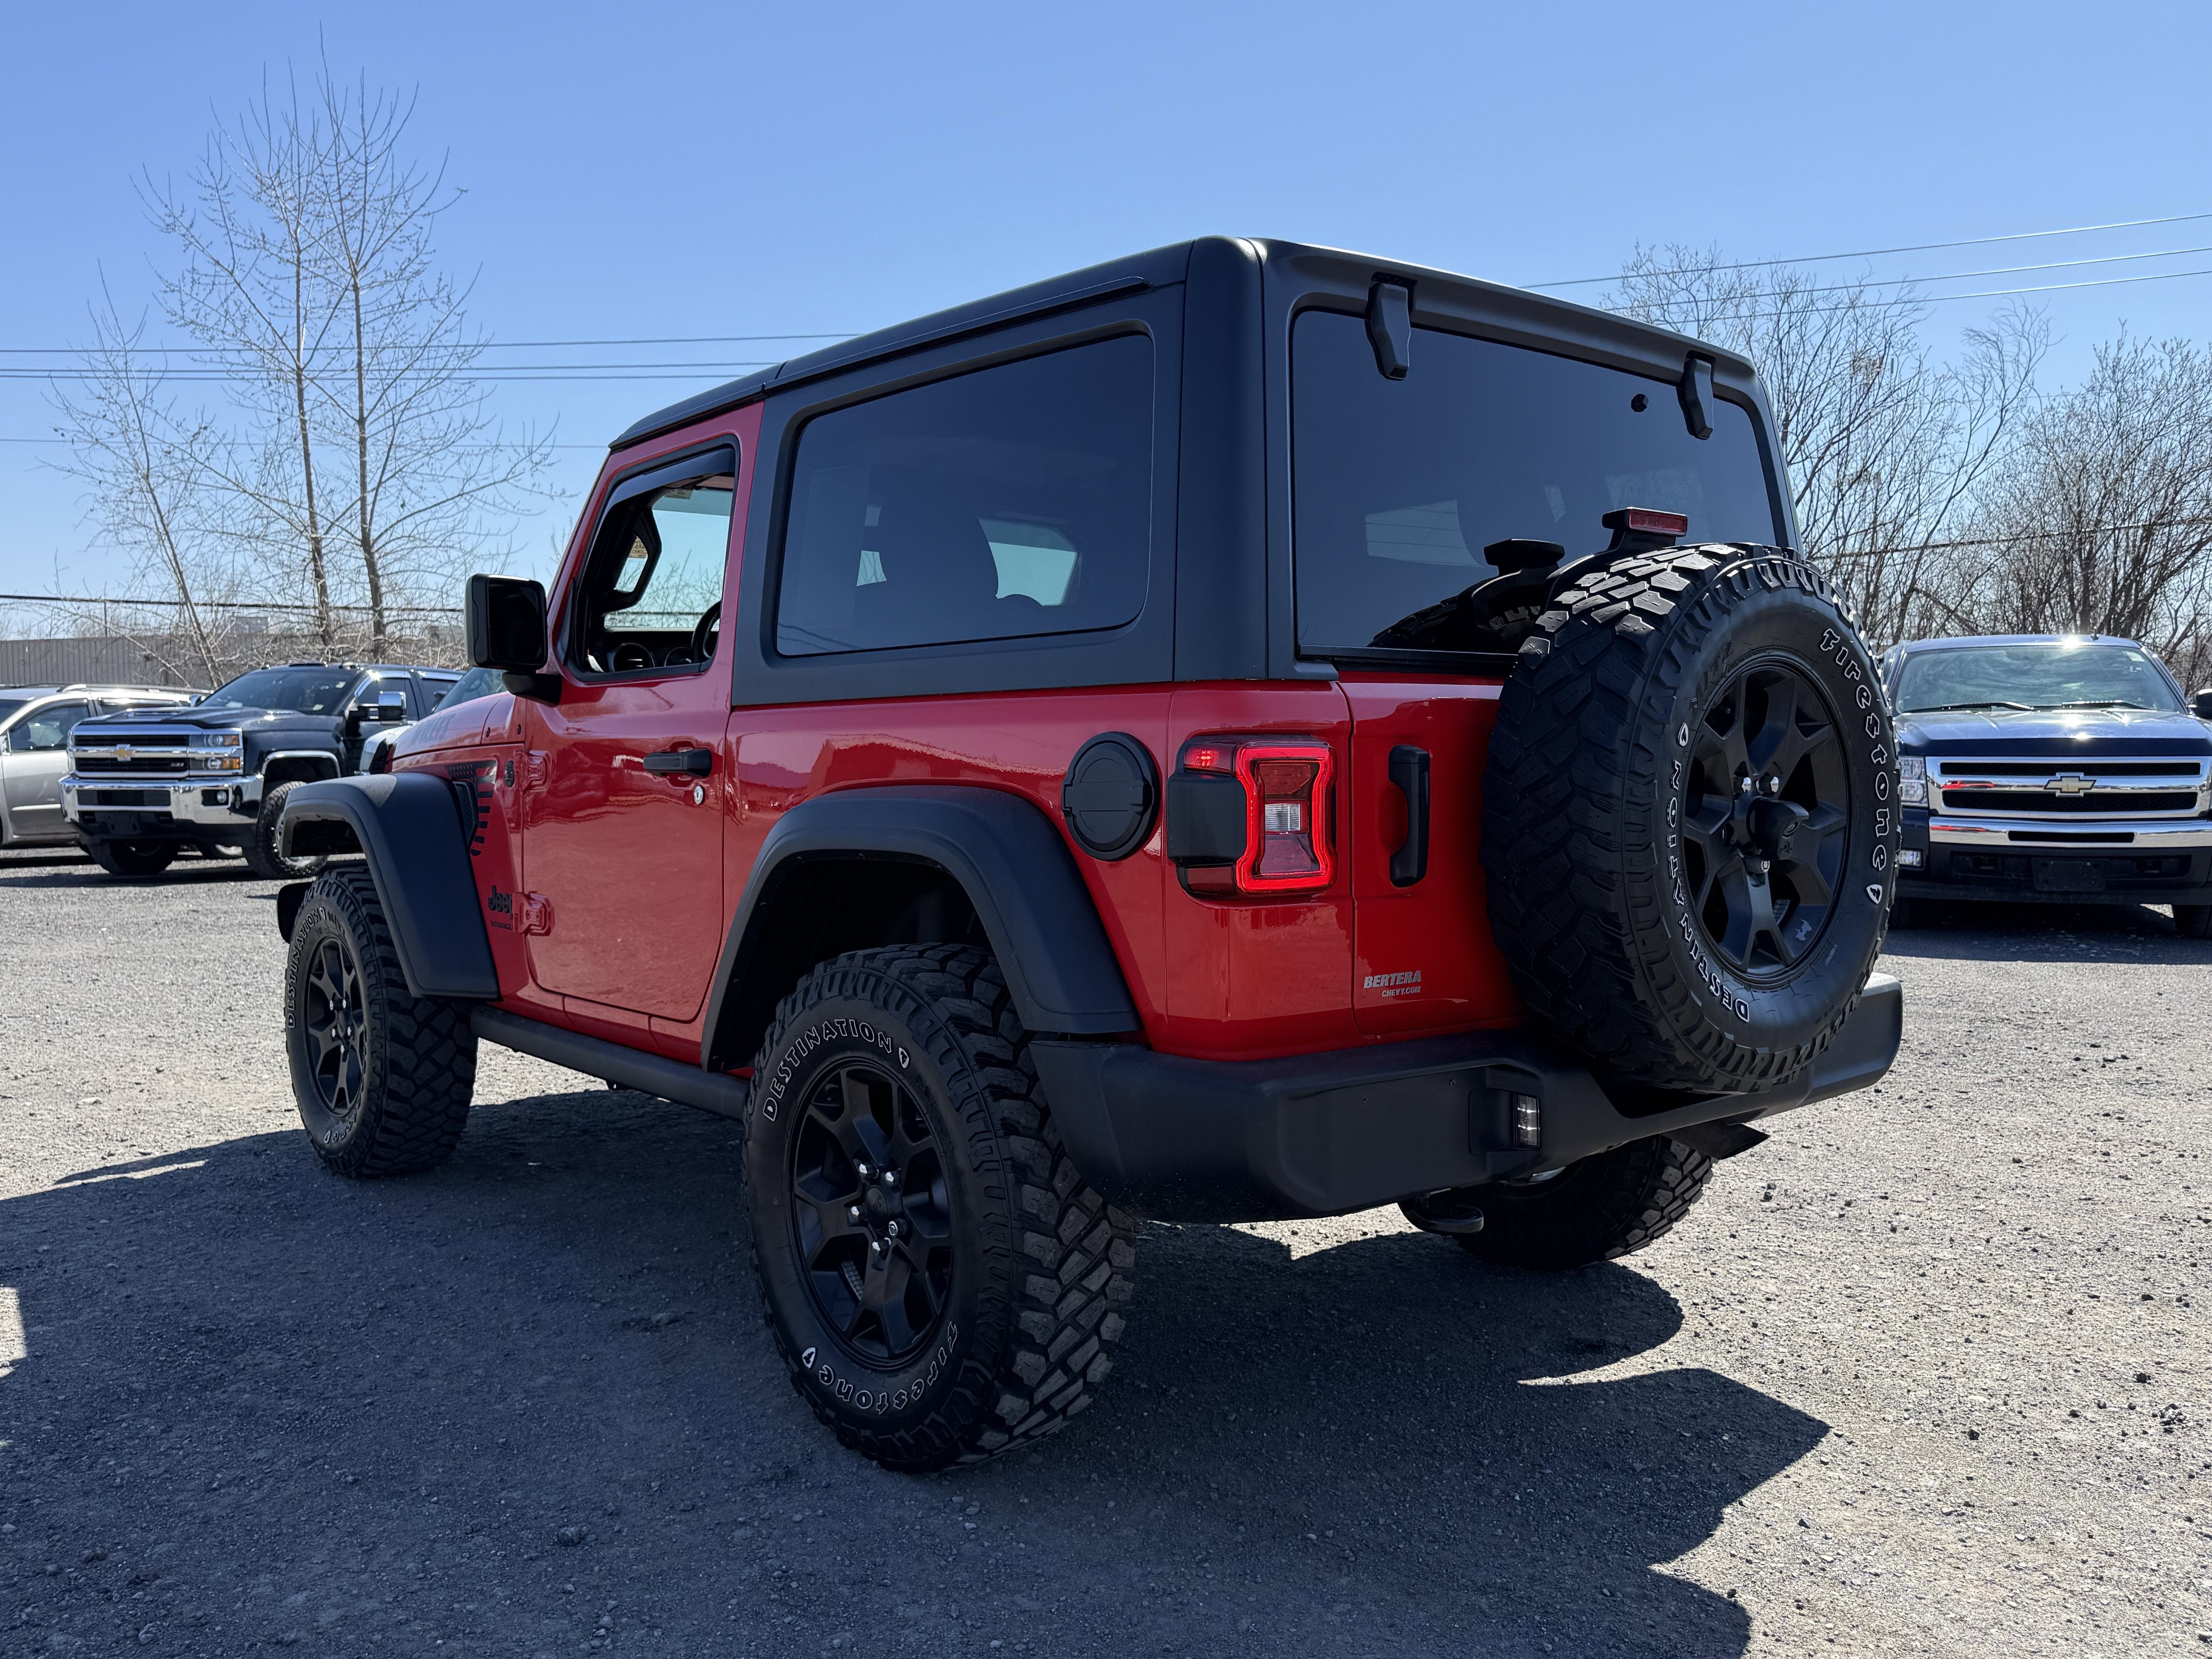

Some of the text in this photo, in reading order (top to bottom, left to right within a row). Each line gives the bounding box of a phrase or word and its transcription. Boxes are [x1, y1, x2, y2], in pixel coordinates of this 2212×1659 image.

[1820, 628, 1889, 871] Firestone
[1667, 759, 1750, 1022] DESTINATION
[287, 909, 321, 1029] DESTINATION
[1363, 970, 1421, 989] BERTERA
[1381, 986, 1421, 998] CHEVY.COM
[763, 1018, 892, 1122] DESTINATION
[819, 1321, 958, 1416] Firestone
